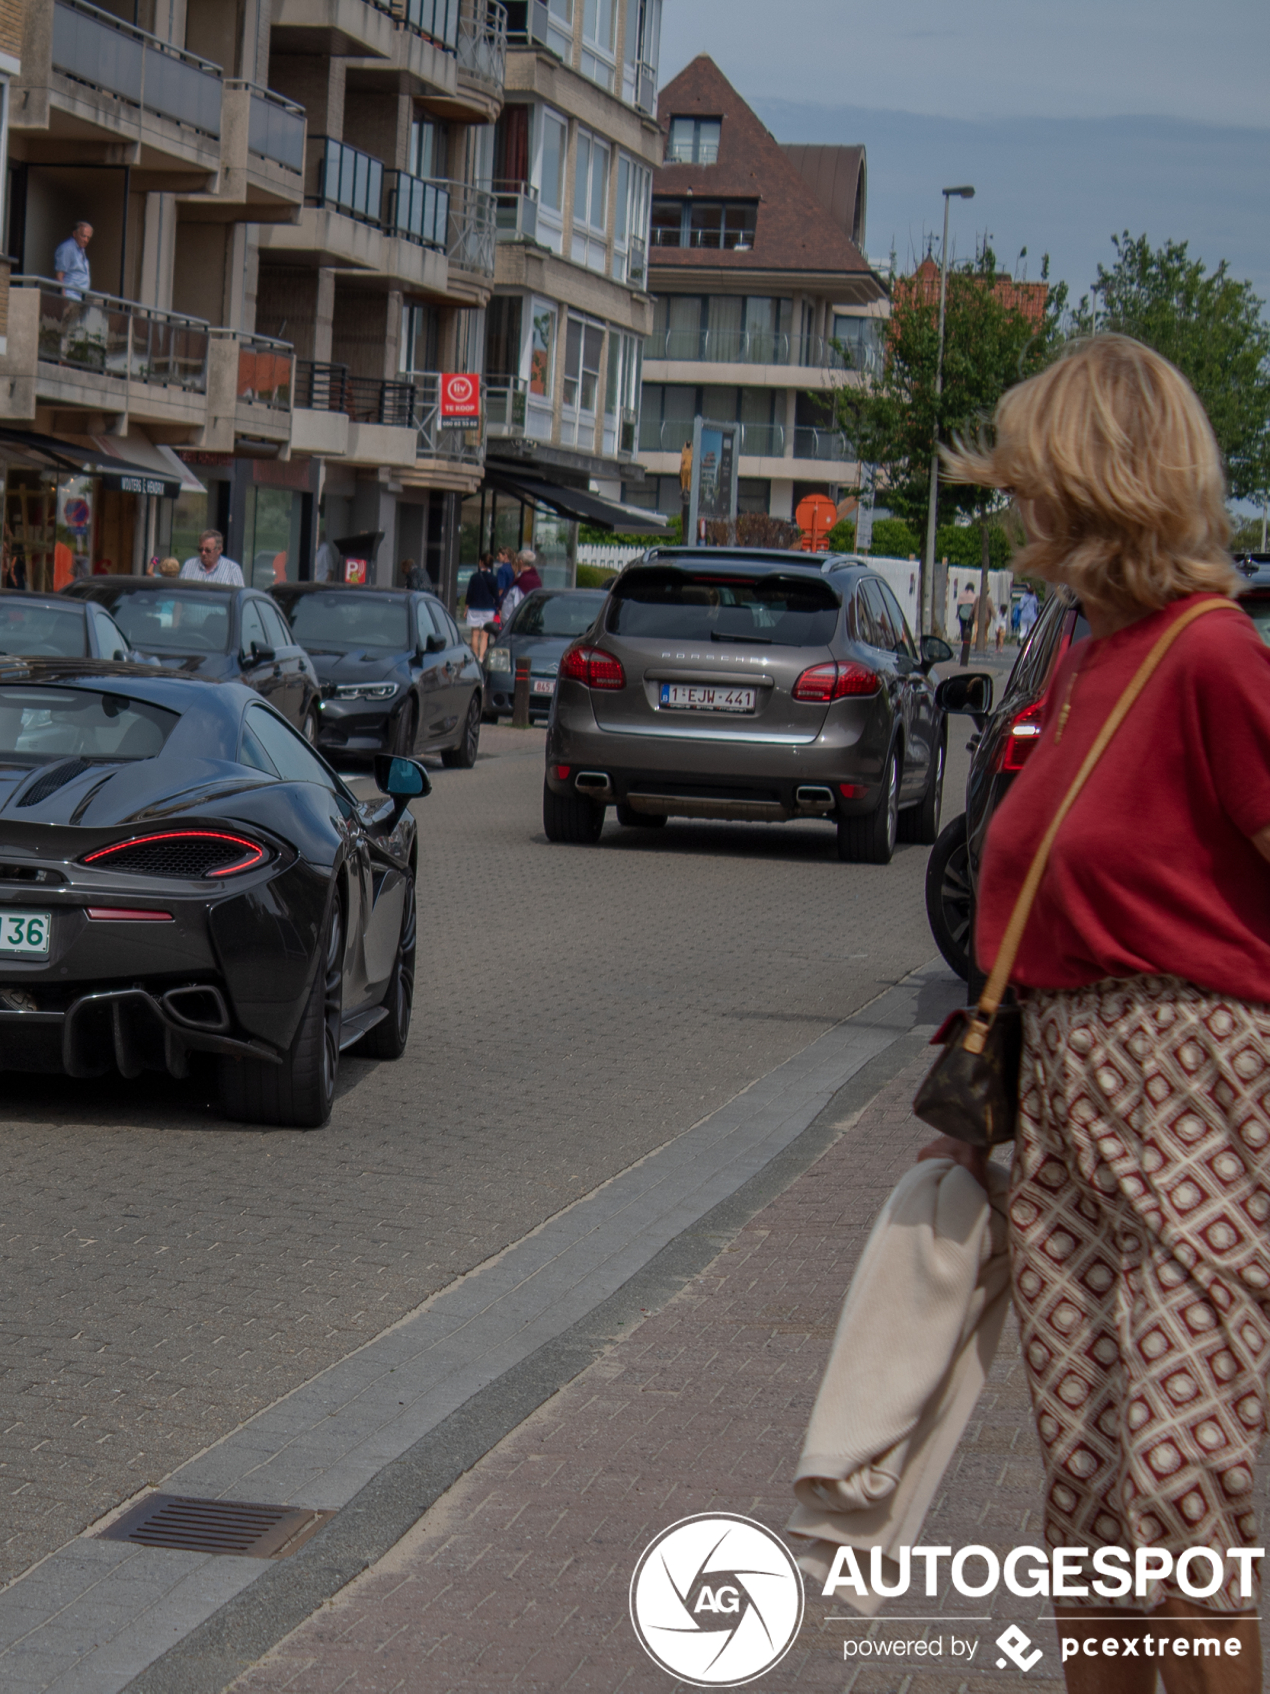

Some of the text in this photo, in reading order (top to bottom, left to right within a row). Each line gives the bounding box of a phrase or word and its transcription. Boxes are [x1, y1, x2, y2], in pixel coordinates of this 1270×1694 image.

[445, 404, 475, 412] TE KOOP
[661, 652, 760, 664] PORSCHE
[662, 694, 669, 702] B
